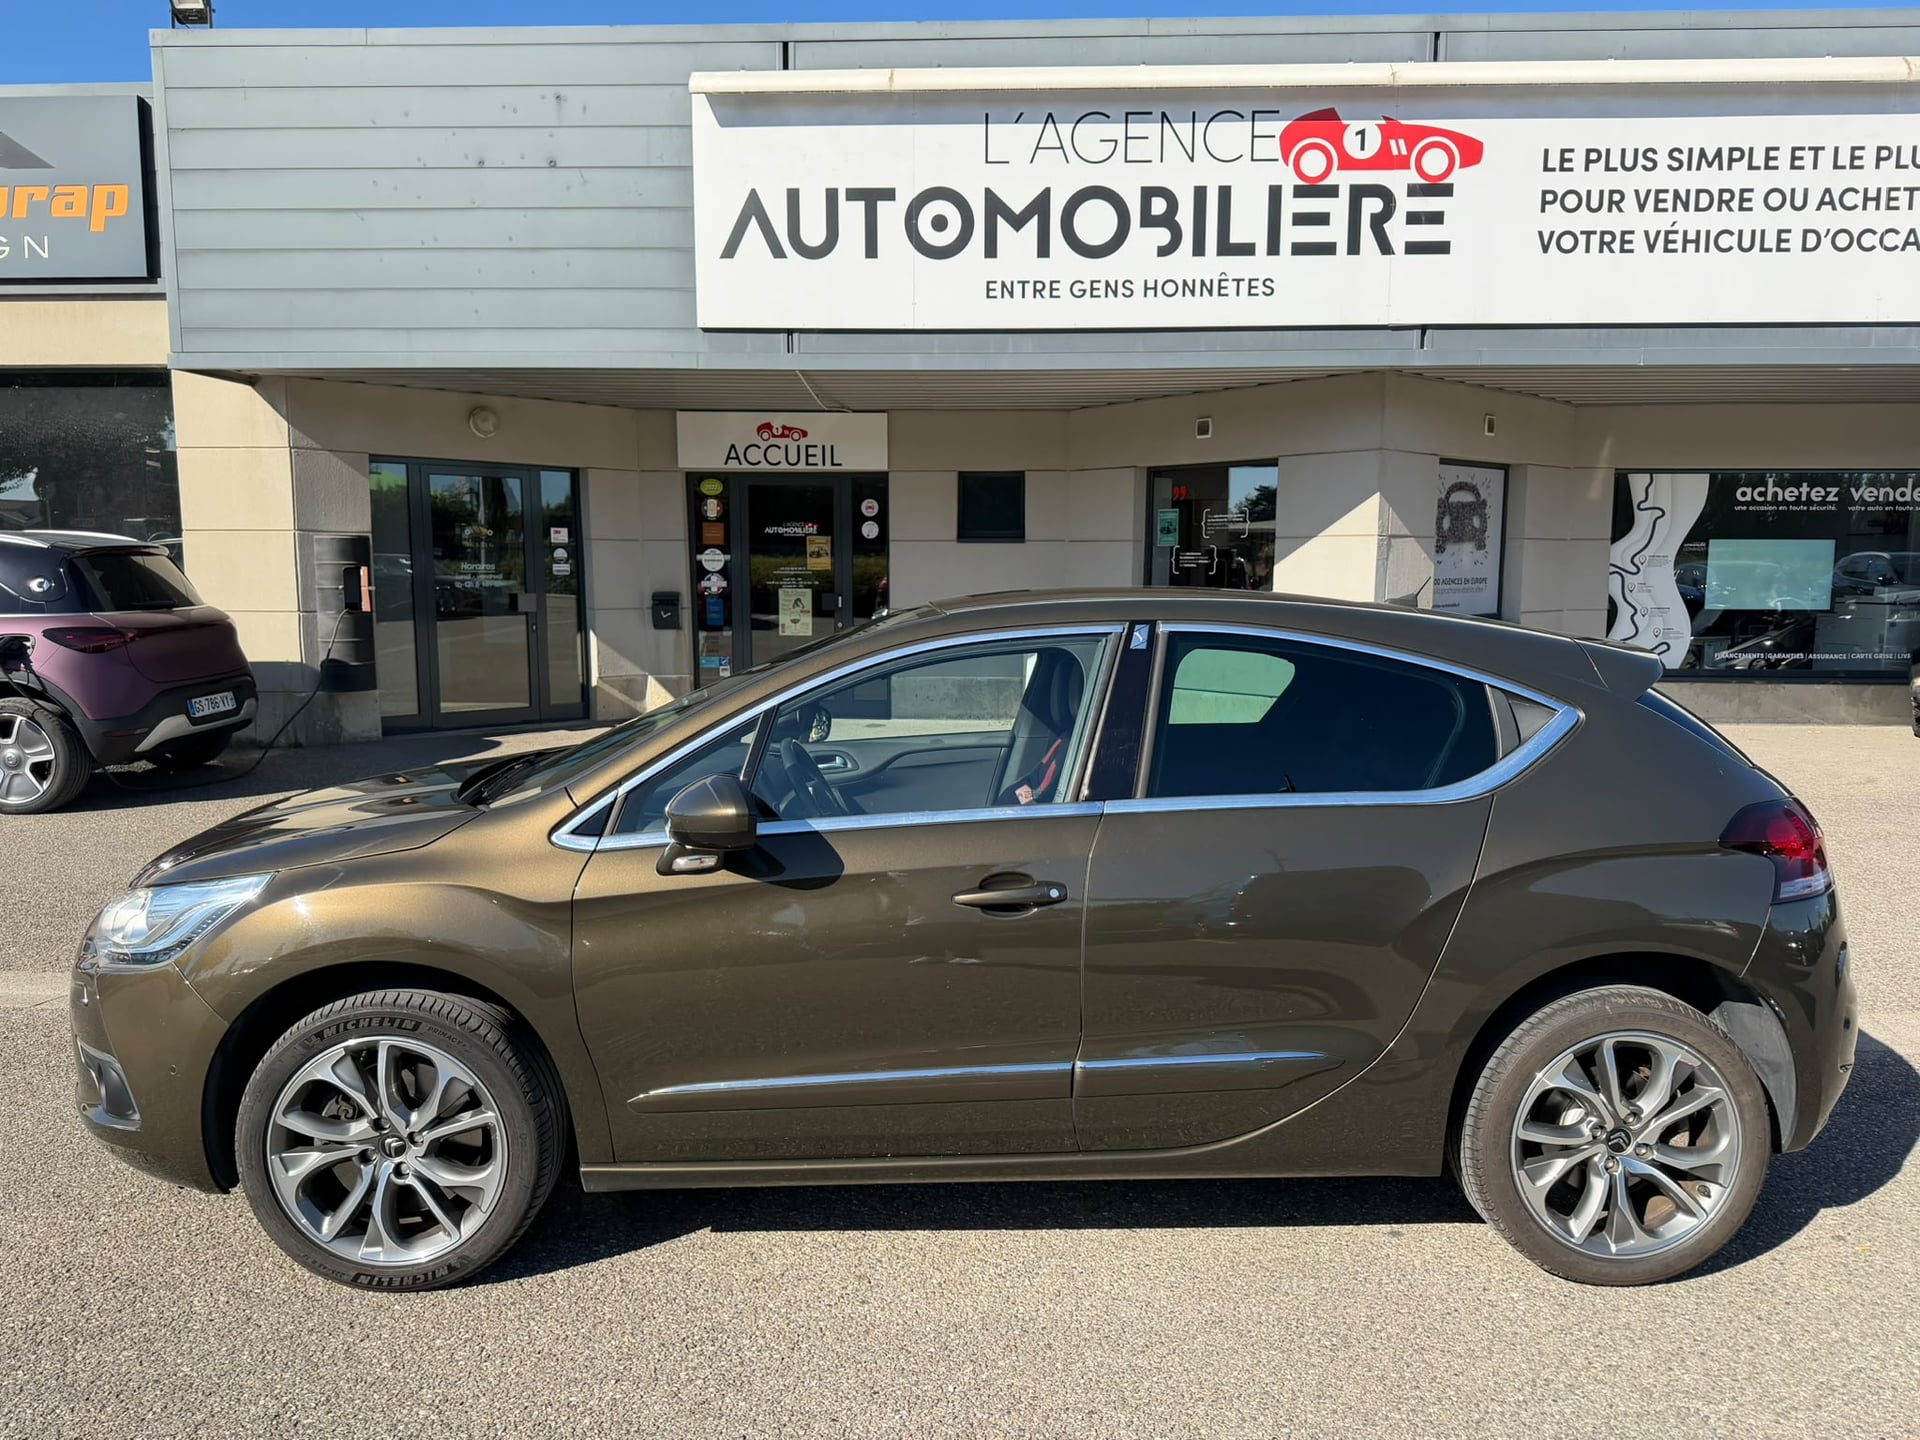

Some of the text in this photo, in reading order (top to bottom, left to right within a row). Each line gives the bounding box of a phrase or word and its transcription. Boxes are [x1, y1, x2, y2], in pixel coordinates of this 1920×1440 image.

[984, 109, 1281, 164] L'AGENCE
[1354, 128, 1367, 151] 1
[1542, 148, 1575, 172] LE
[1584, 148, 1658, 172] PLUS
[1667, 146, 1780, 171] SIMPLE
[1789, 146, 1826, 170] ET
[1832, 145, 1866, 170] LE
[1540, 189, 1626, 214] POUR
[1634, 188, 1755, 213] VENDRE
[1763, 187, 1809, 212] OU
[1537, 230, 1636, 254] VOTRE
[1643, 221, 1792, 254] VÉHICULE
[985, 271, 1275, 299] ENTRE GENS HONNÊTES
[724, 443, 843, 467] ACCUEIL
[1735, 477, 1840, 502] achetez
[1748, 503, 1778, 511] occasion
[1714, 652, 1765, 660] FINANCEMENTS
[1767, 652, 1804, 660] GARANTIES
[322, 1016, 418, 1039] MICHELIN
[356, 1265, 450, 1288] MICHELIN
